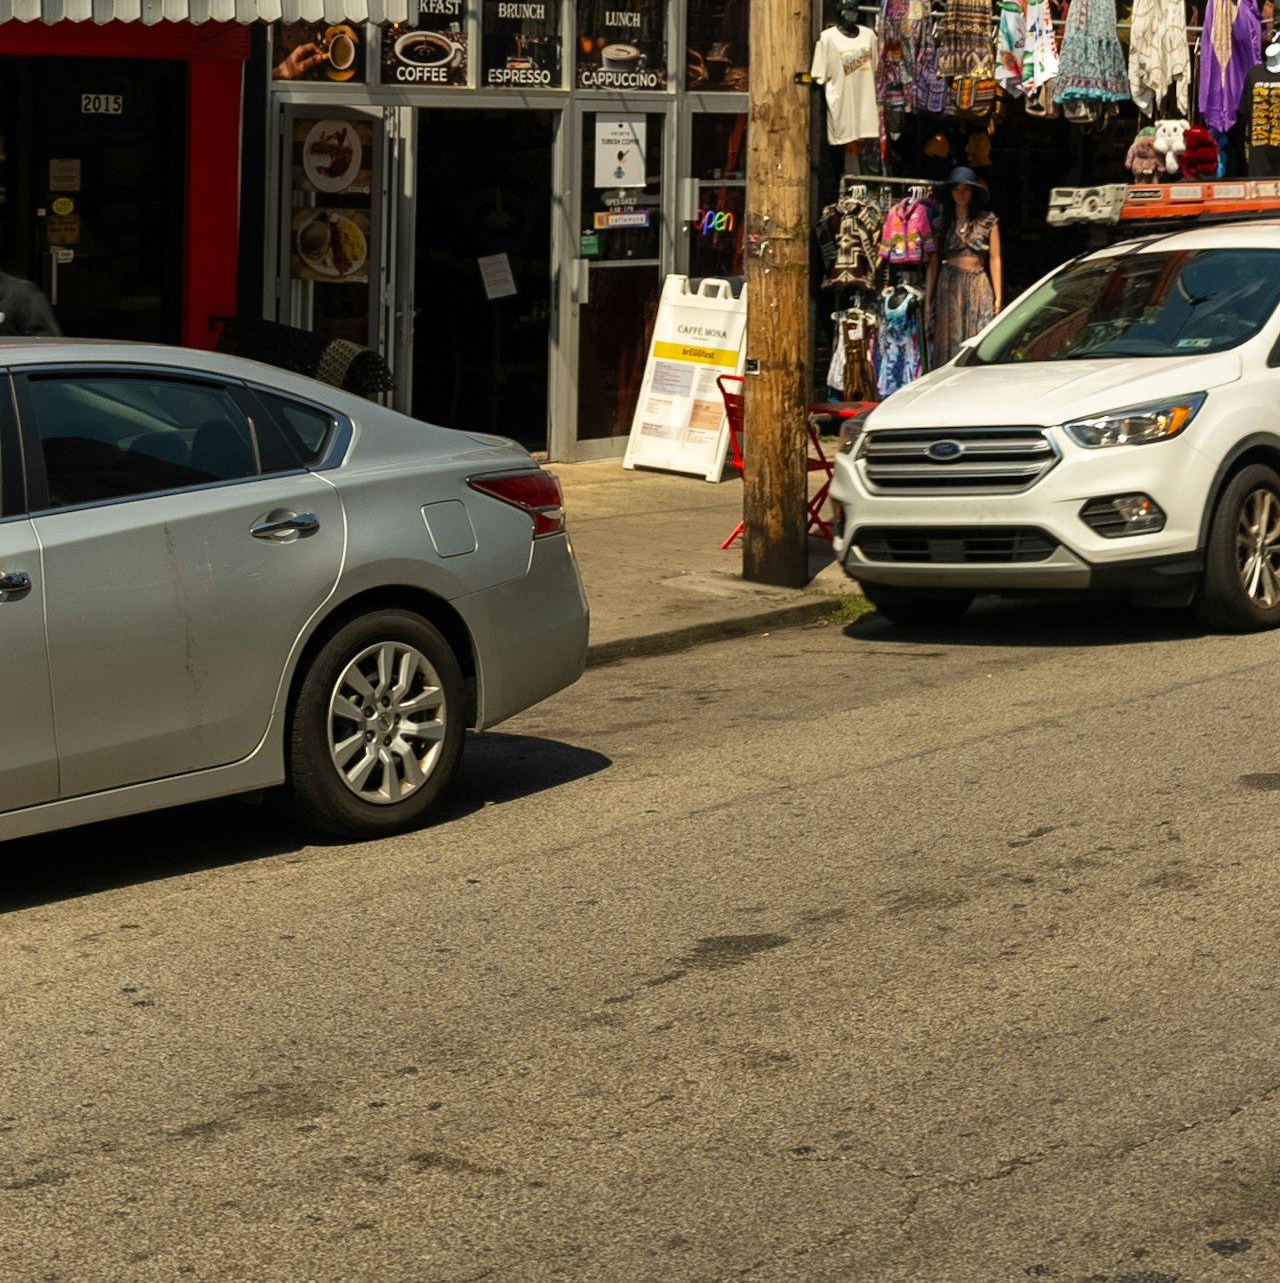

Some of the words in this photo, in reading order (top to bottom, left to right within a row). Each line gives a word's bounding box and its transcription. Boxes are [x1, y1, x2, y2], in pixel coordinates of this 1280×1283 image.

[498, 1, 546, 19] BRUNCH
[605, 11, 641, 28] LUNCH
[396, 66, 448, 83] COFFEE
[488, 68, 551, 84] ESPRESSO
[581, 71, 657, 87] CAPPUCCINO
[83, 95, 121, 112] 2015
[705, 329, 727, 339] MONA
